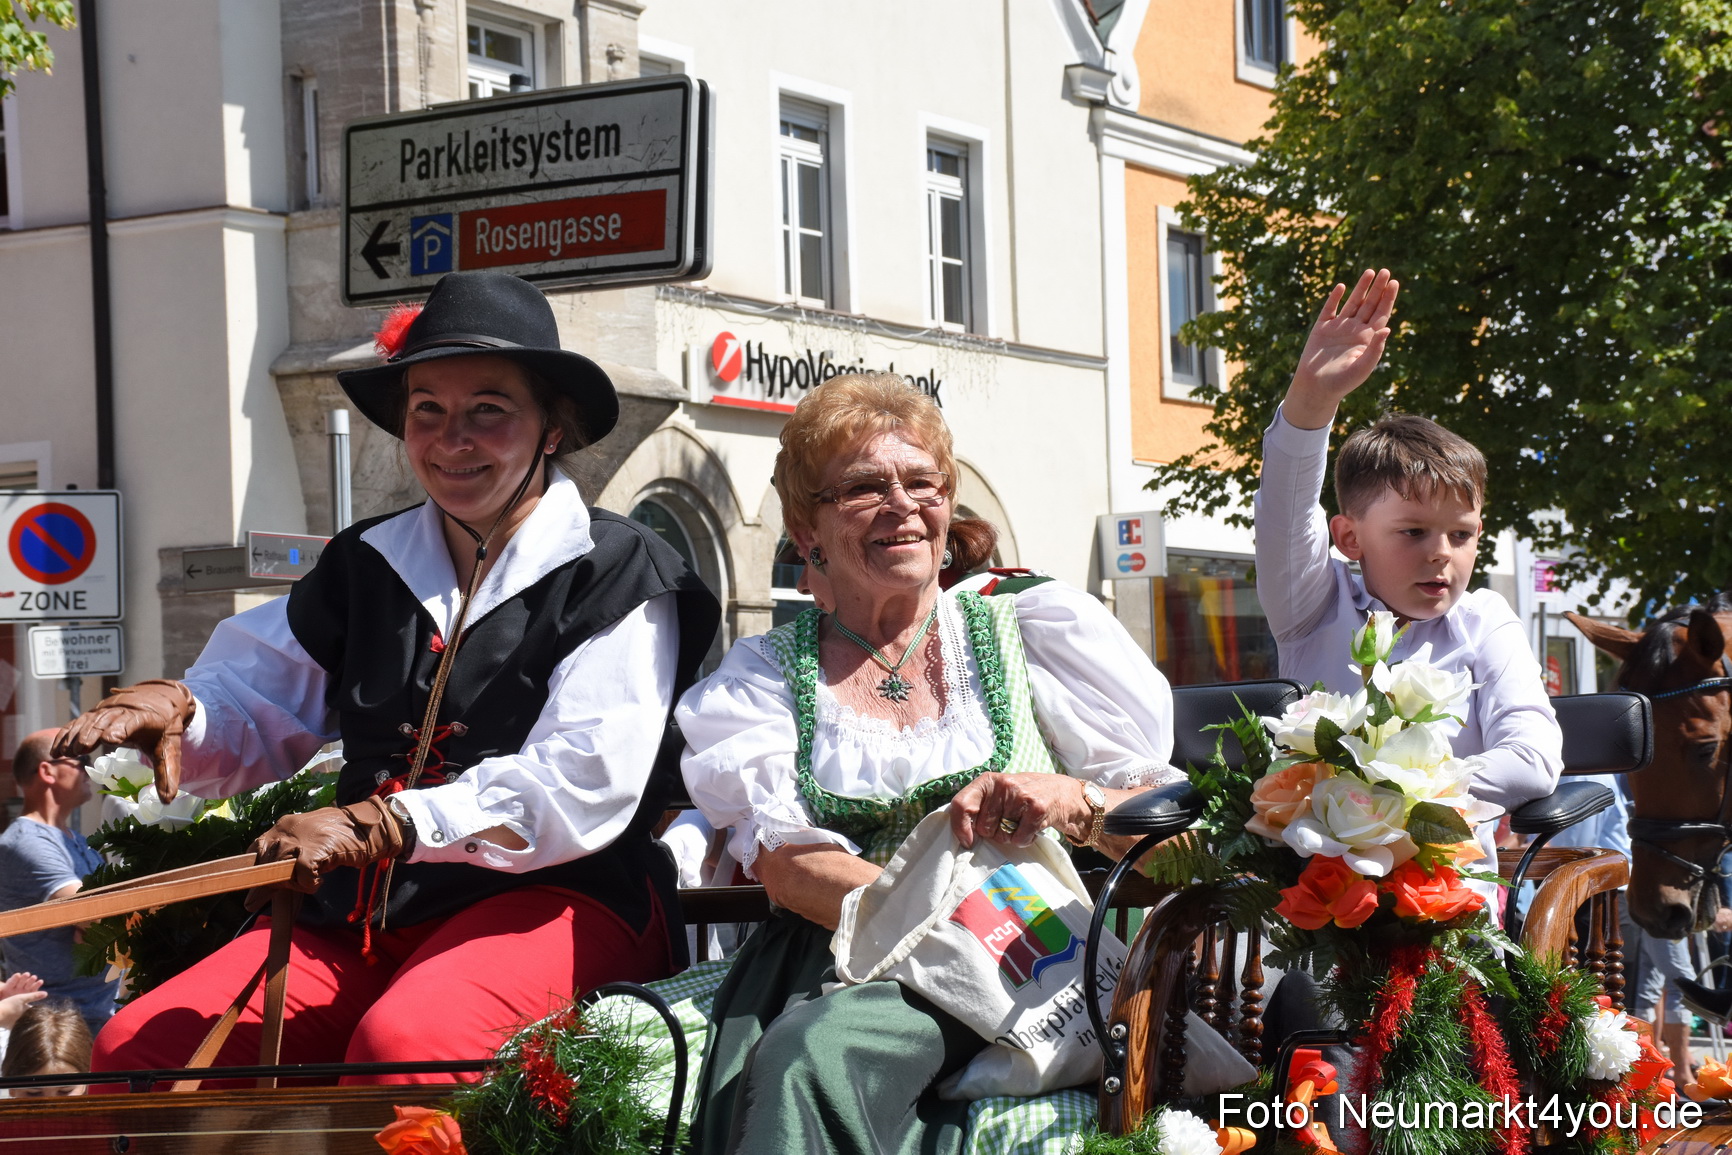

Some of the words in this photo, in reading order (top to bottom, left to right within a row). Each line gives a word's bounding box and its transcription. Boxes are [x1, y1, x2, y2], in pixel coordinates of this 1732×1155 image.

[399, 119, 622, 184] Parkleitsystem
[423, 234, 443, 270] P
[475, 211, 623, 257] Rosengasse
[746, 339, 943, 409] HypoVeank
[20, 590, 87, 611] ZONE
[44, 633, 111, 647] Bewohner
[59, 646, 112, 657] Parkausweis
[66, 656, 89, 670] frei
[995, 971, 1114, 1051] Oberpfäle
[1075, 1026, 1097, 1047] in
